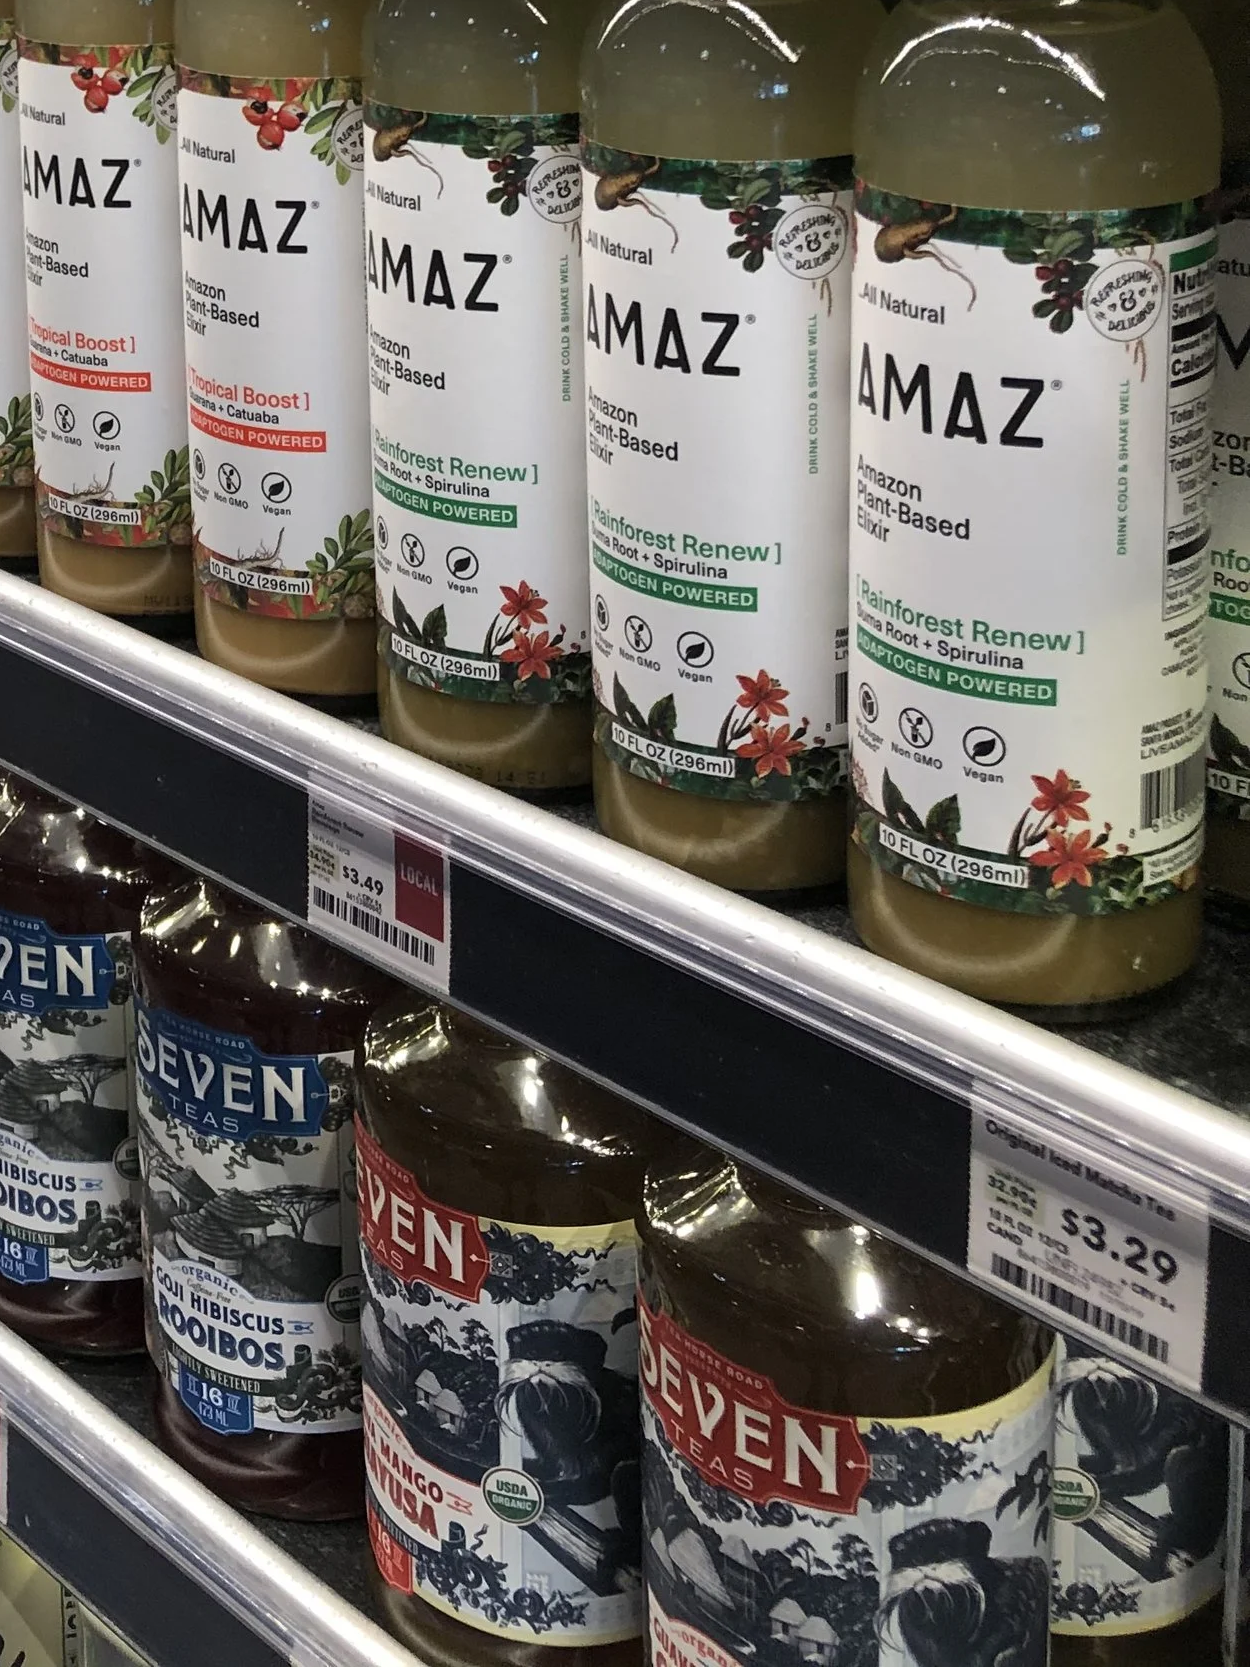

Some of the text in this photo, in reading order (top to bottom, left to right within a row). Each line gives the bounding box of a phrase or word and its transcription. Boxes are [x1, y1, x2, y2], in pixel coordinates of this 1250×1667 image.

[376, 184, 421, 211] Natural
[600, 232, 653, 266] Natural
[880, 291, 945, 325] Natural
[1090, 269, 1152, 308] REFRESHING
[186, 290, 260, 328] Plant-Based
[1108, 301, 1156, 332] DELICIOUS
[75, 332, 126, 352] Boost
[80, 372, 148, 389] POWERED
[191, 366, 300, 409] Tropical Boost
[227, 404, 280, 425] Catuaba
[588, 386, 638, 427] Amazon
[248, 430, 323, 448] POWERED
[588, 407, 679, 462] Plant-Based
[375, 428, 527, 482] Rainforest Renew
[1117, 380, 1130, 556] DRINK COLD SHAKE WELL
[425, 475, 490, 499] Spirulina
[857, 454, 922, 503] Amazon
[432, 501, 514, 523] POWERED
[857, 479, 971, 541] Plant-Based
[857, 504, 890, 543] Elixir
[593, 499, 770, 562] Rainforest Renew
[612, 536, 728, 580] Root Spirulina
[662, 584, 754, 607] POWERED
[861, 579, 1071, 652] Rainforest Renew
[857, 633, 1051, 700] ADAPTOGEN POWERED
[885, 623, 919, 650] Root
[937, 639, 1024, 671] Spirulina
[669, 750, 734, 776] (296ml)
[891, 741, 943, 770] Non GMO
[963, 766, 1004, 784] Vegan
[881, 829, 1026, 887] 10 FL OZ (296ml)
[342, 865, 384, 896] $3.49
[400, 863, 439, 897] LOCAL
[137, 1009, 308, 1123] SEVEN
[168, 1093, 240, 1134] TEAS
[985, 1119, 1045, 1160] Original
[1049, 1148, 1082, 1178] Iced
[1060, 1207, 1178, 1284] $3.29
[181, 1264, 238, 1296] organic
[156, 1266, 285, 1335] GOJI HIBISCUS
[159, 1289, 286, 1371] ROOIBOS
[201, 1382, 223, 1406] 16
[204, 1369, 260, 1394] SWEETENED
[640, 1305, 840, 1496] SEVEN
[380, 1440, 444, 1504] MANGO
[670, 1418, 754, 1491] TEAS
[492, 1494, 532, 1511] ORGANIC
[496, 1479, 528, 1497] USDA
